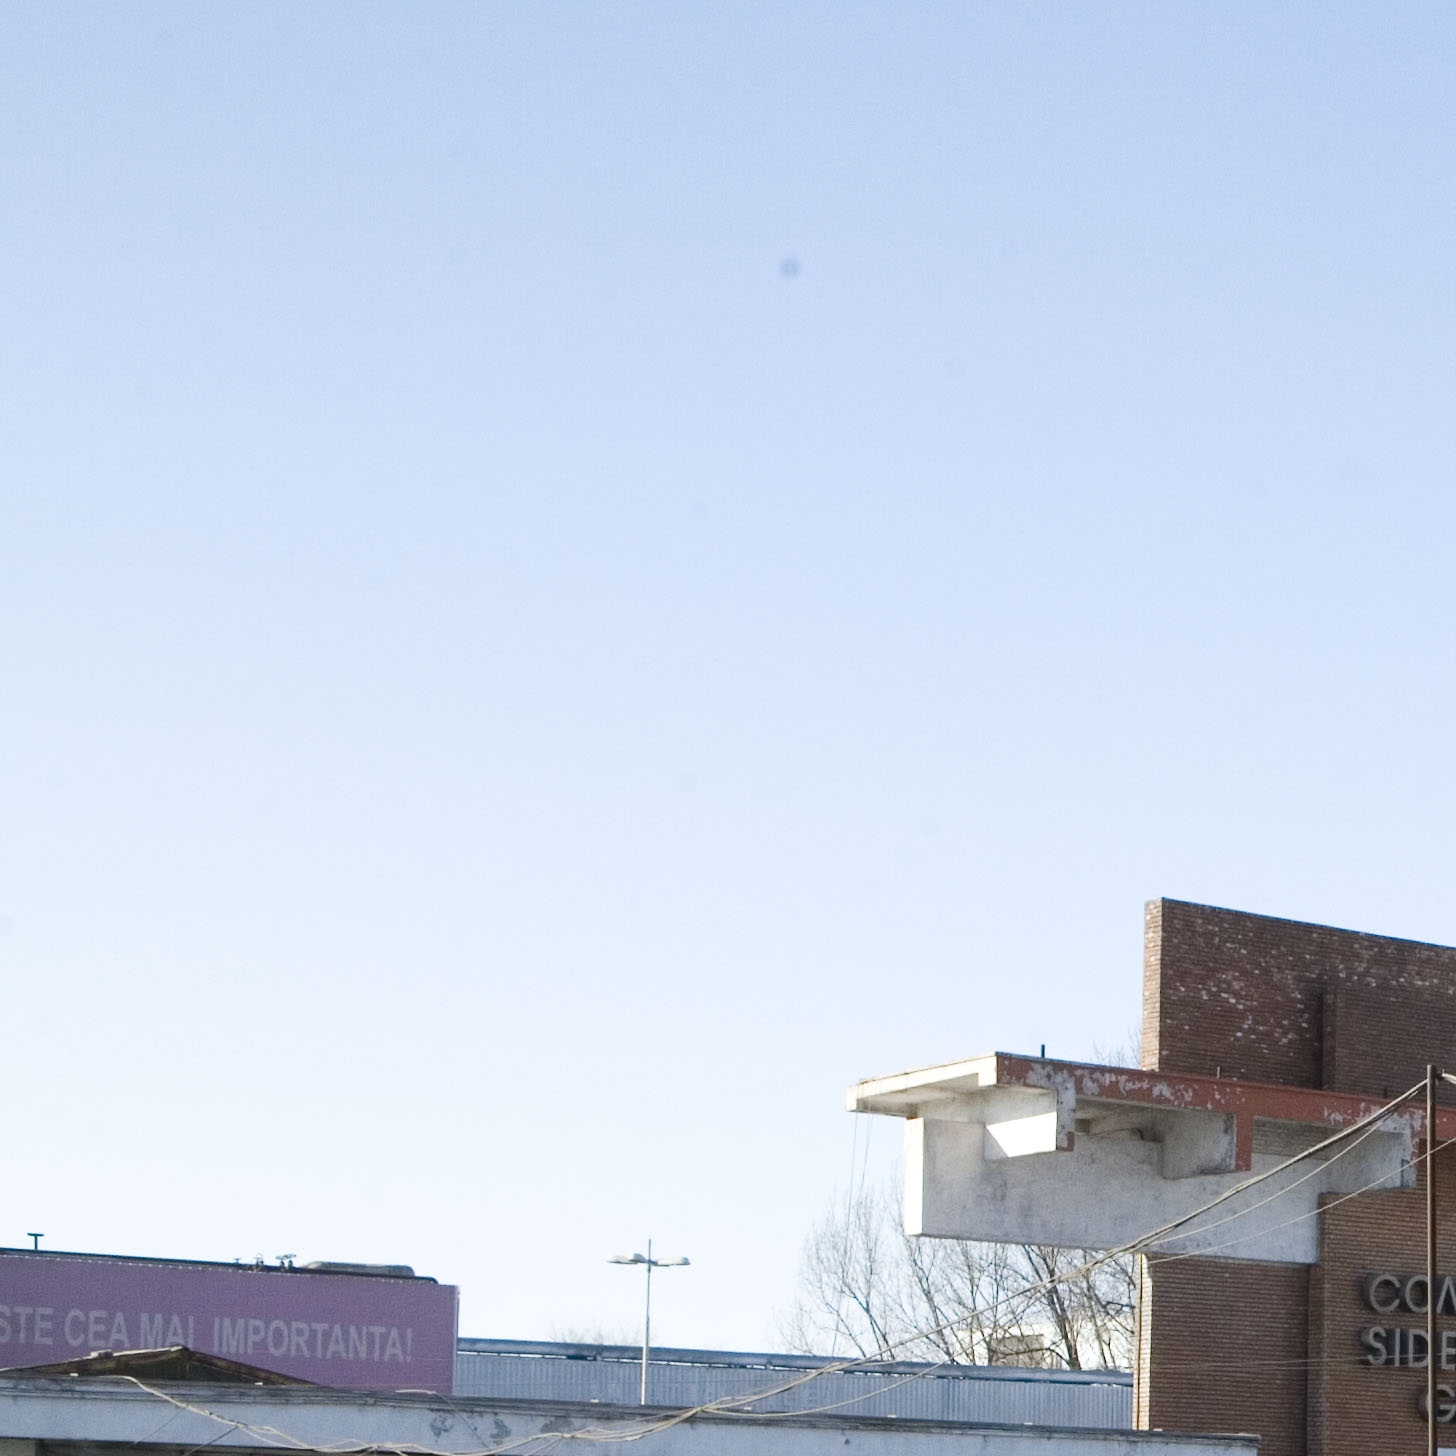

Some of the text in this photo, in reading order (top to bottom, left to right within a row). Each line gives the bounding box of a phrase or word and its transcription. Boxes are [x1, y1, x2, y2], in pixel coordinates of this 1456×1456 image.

[64, 1308, 131, 1348] CEA
[139, 1312, 194, 1351] MAI
[213, 1317, 413, 1363] IMPORTANTA!
